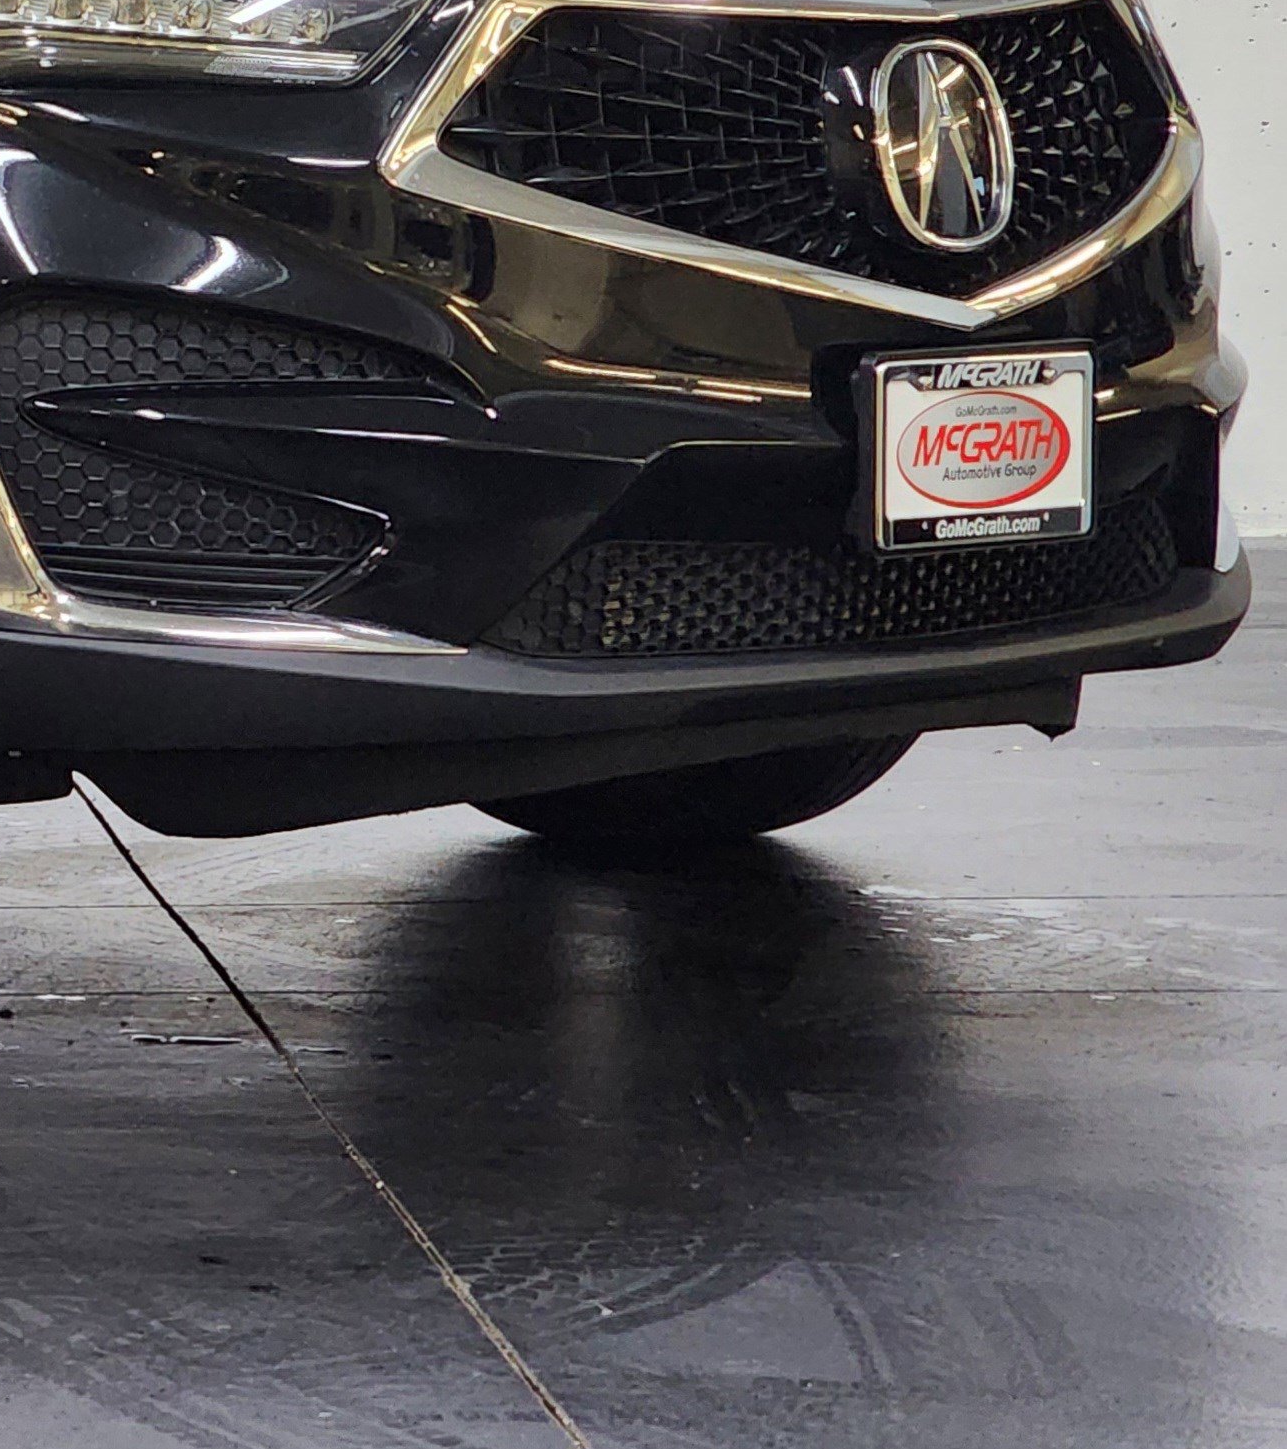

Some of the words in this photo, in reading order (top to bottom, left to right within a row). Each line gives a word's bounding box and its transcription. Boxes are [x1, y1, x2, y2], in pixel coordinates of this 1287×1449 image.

[955, 405, 1017, 418] GoMcGrath.com
[942, 466, 1001, 481] Automotive
[1004, 464, 1037, 479] Group
[936, 517, 1040, 538] GoMcGrath.com
